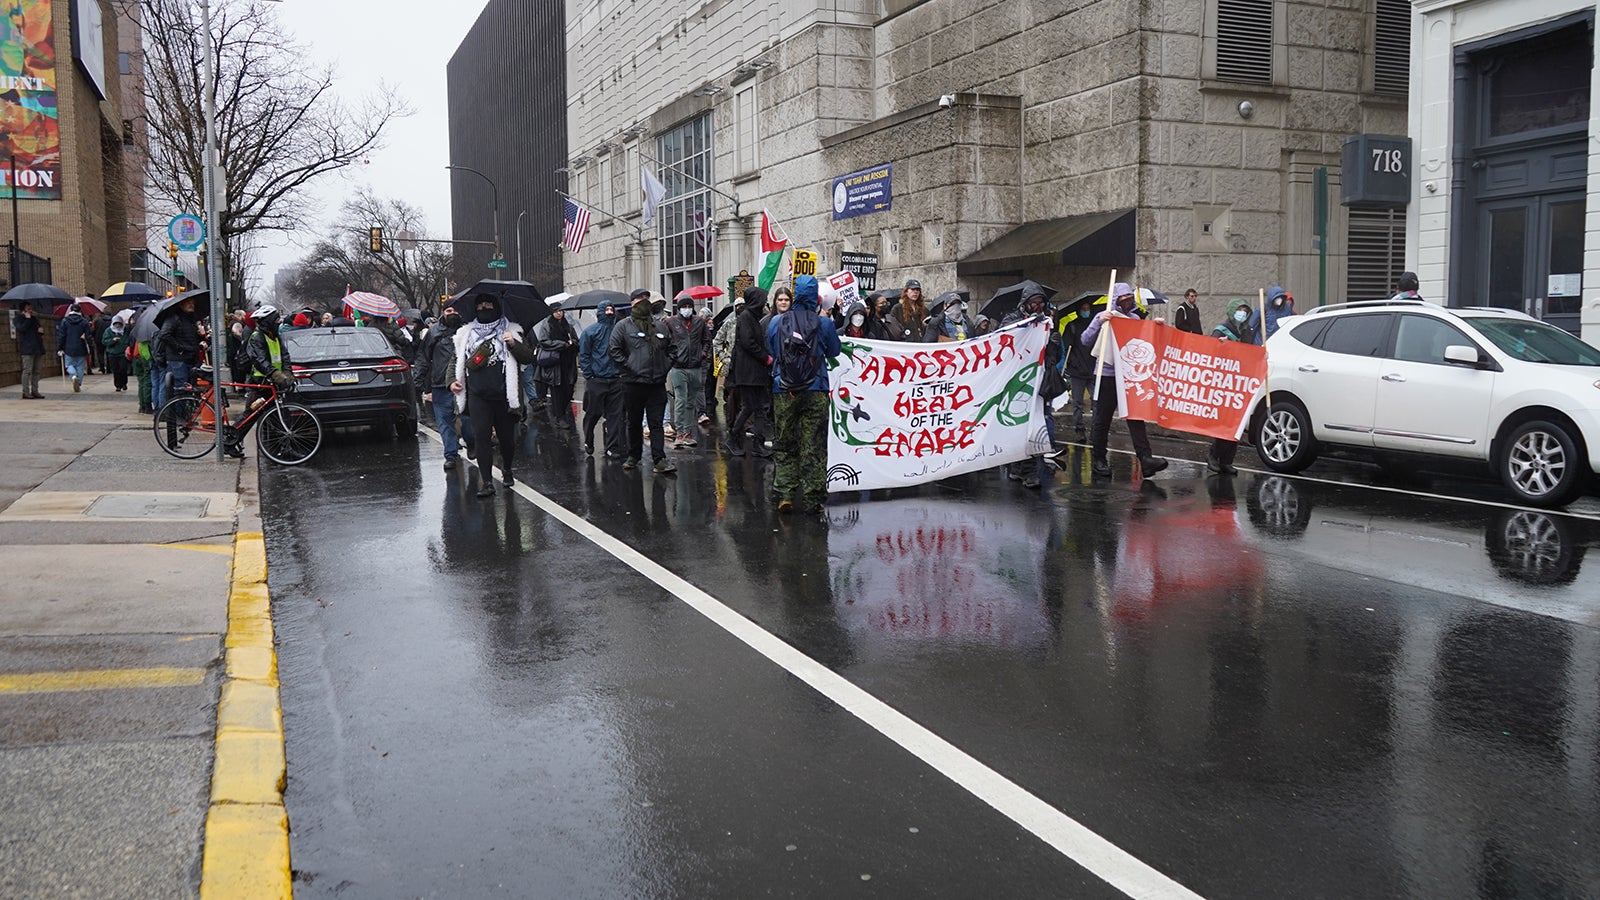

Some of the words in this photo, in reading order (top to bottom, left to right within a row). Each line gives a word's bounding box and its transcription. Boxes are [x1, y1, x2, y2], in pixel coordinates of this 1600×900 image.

[1372, 149, 1402, 172] 718
[842, 256, 877, 264] COLONIALISM
[843, 265, 861, 273] MUST
[862, 266, 875, 274] END
[840, 287, 854, 296] FUND
[1164, 345, 1240, 373] PHILADELPHIA
[1160, 360, 1260, 394] DEMOCRATIC
[912, 387, 923, 397] IS
[931, 381, 955, 394] THE
[1158, 377, 1244, 410] SOCIALISTS
[894, 385, 974, 418] HEAD
[1165, 398, 1218, 420] AMERICA
[911, 415, 928, 428] OF
[929, 412, 953, 425] THE
[874, 420, 977, 458] SNAKE
